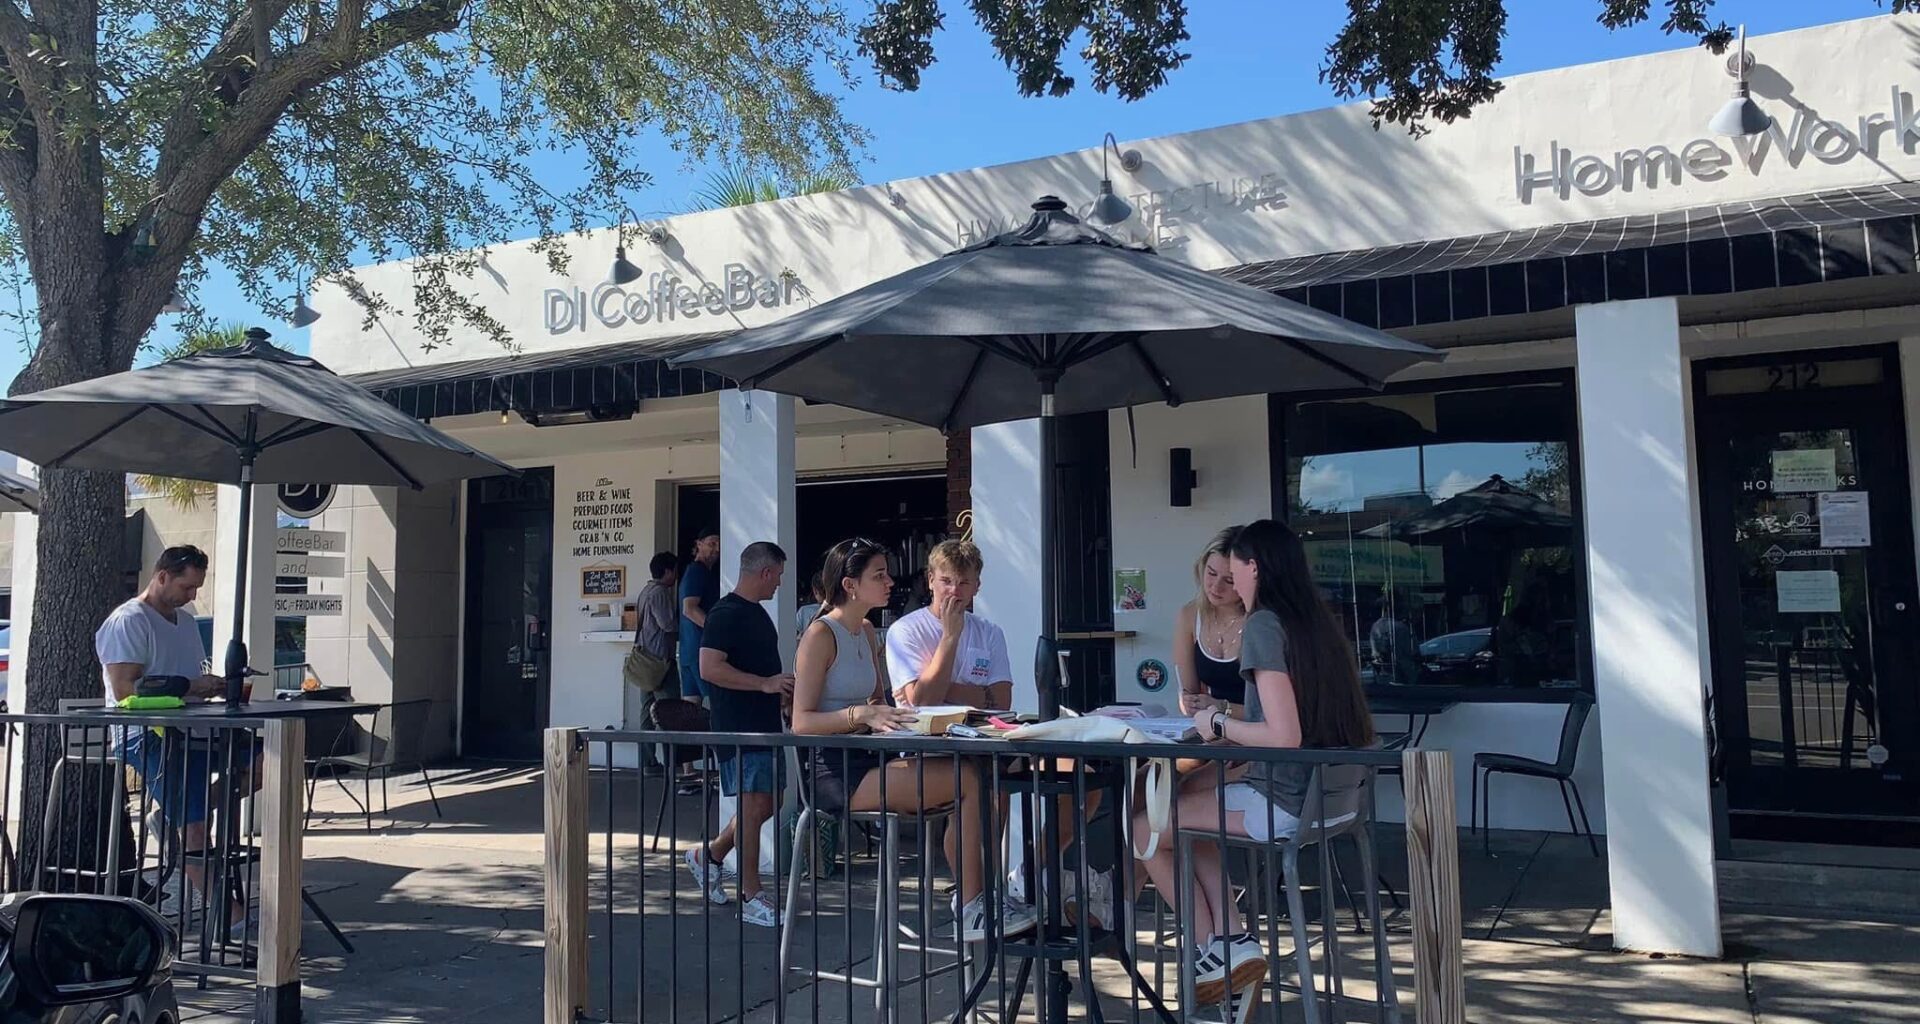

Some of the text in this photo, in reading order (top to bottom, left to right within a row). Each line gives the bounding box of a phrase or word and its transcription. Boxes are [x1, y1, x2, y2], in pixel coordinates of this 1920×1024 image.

[591, 263, 799, 326] CoffeeBar
[1768, 362, 1820, 391] 212
[577, 488, 630, 502] BEER & WINE
[573, 503, 633, 517] PREPARED FOODS
[573, 517, 633, 530] GOURMET ITEMS
[277, 531, 335, 549] offeeBar
[580, 533, 599, 543] GRAB
[614, 532, 624, 542] GO
[573, 544, 634, 556] HOME FURNISHINGS
[295, 599, 321, 611] FRIDAY
[320, 599, 342, 611] NIGHTS
